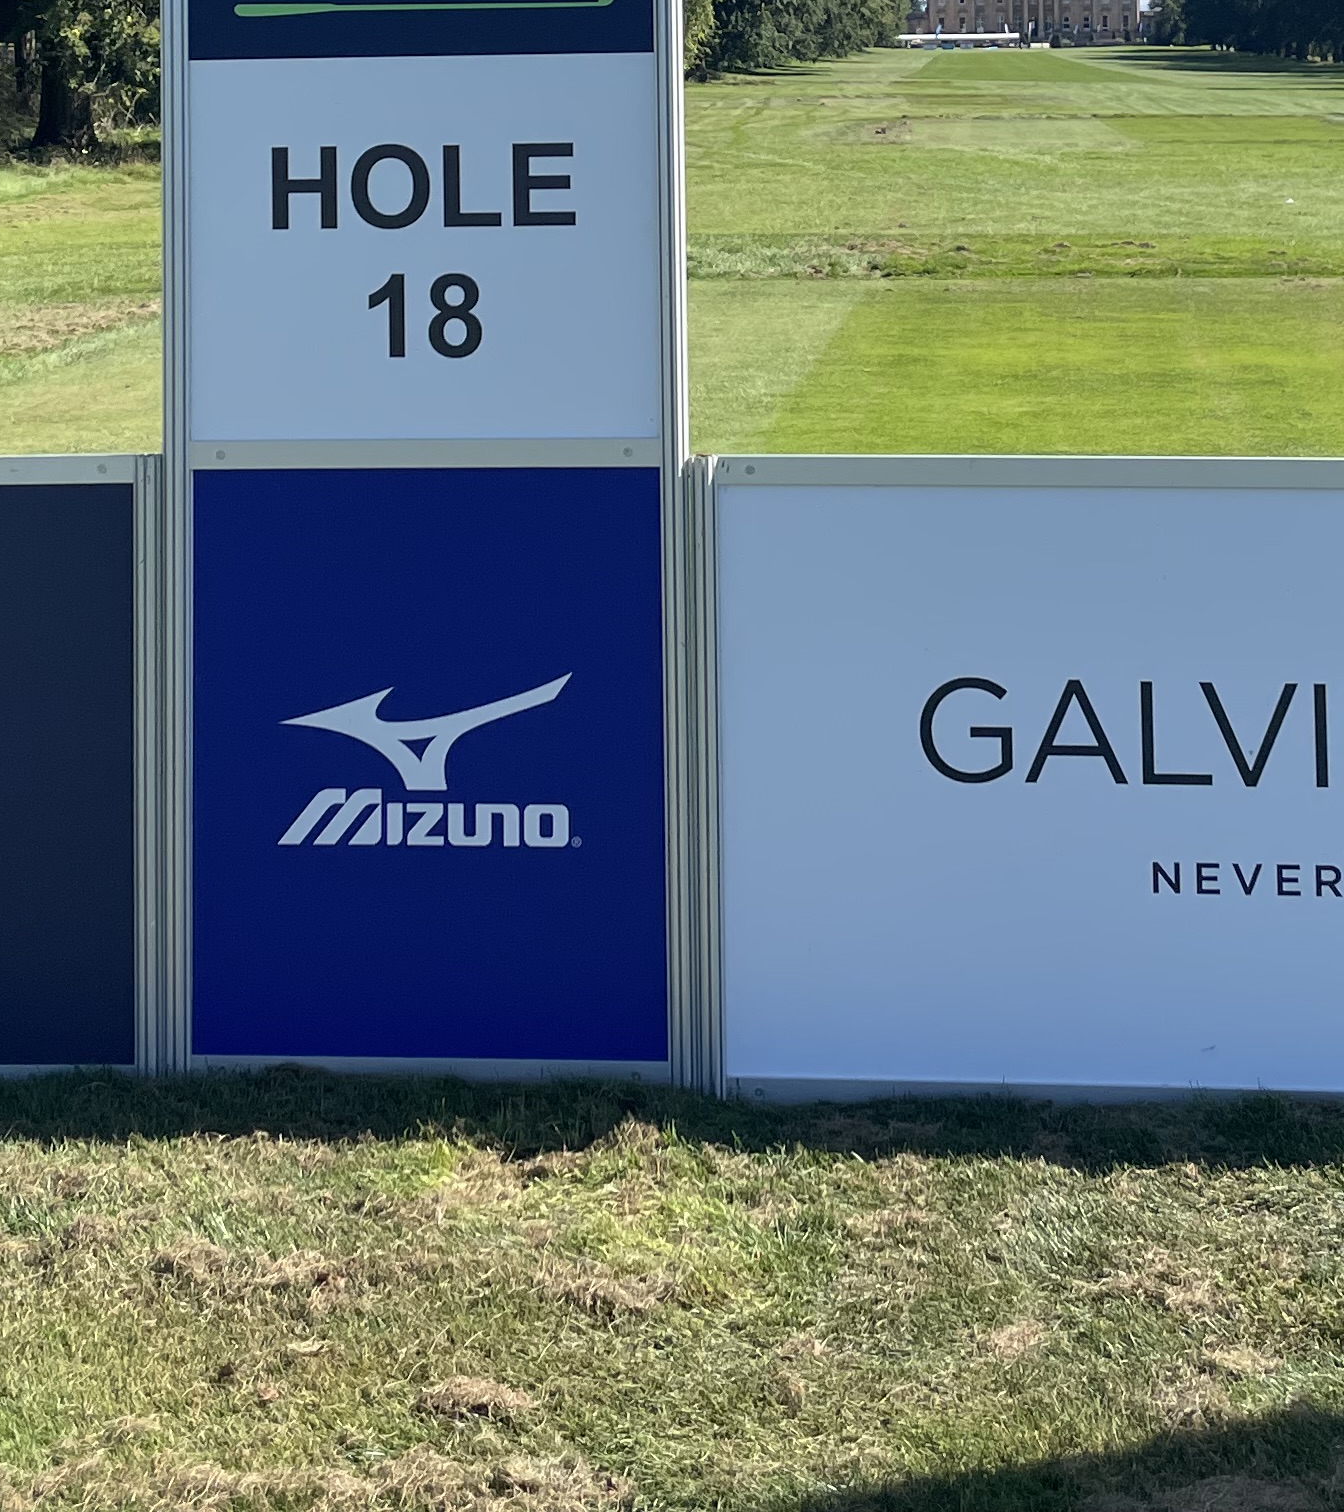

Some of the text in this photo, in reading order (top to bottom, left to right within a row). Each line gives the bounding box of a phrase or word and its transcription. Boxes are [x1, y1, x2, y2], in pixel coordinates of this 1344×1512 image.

[272, 143, 576, 229] HOLE
[369, 274, 482, 358] 18
[1153, 862, 1342, 897] NEVER
